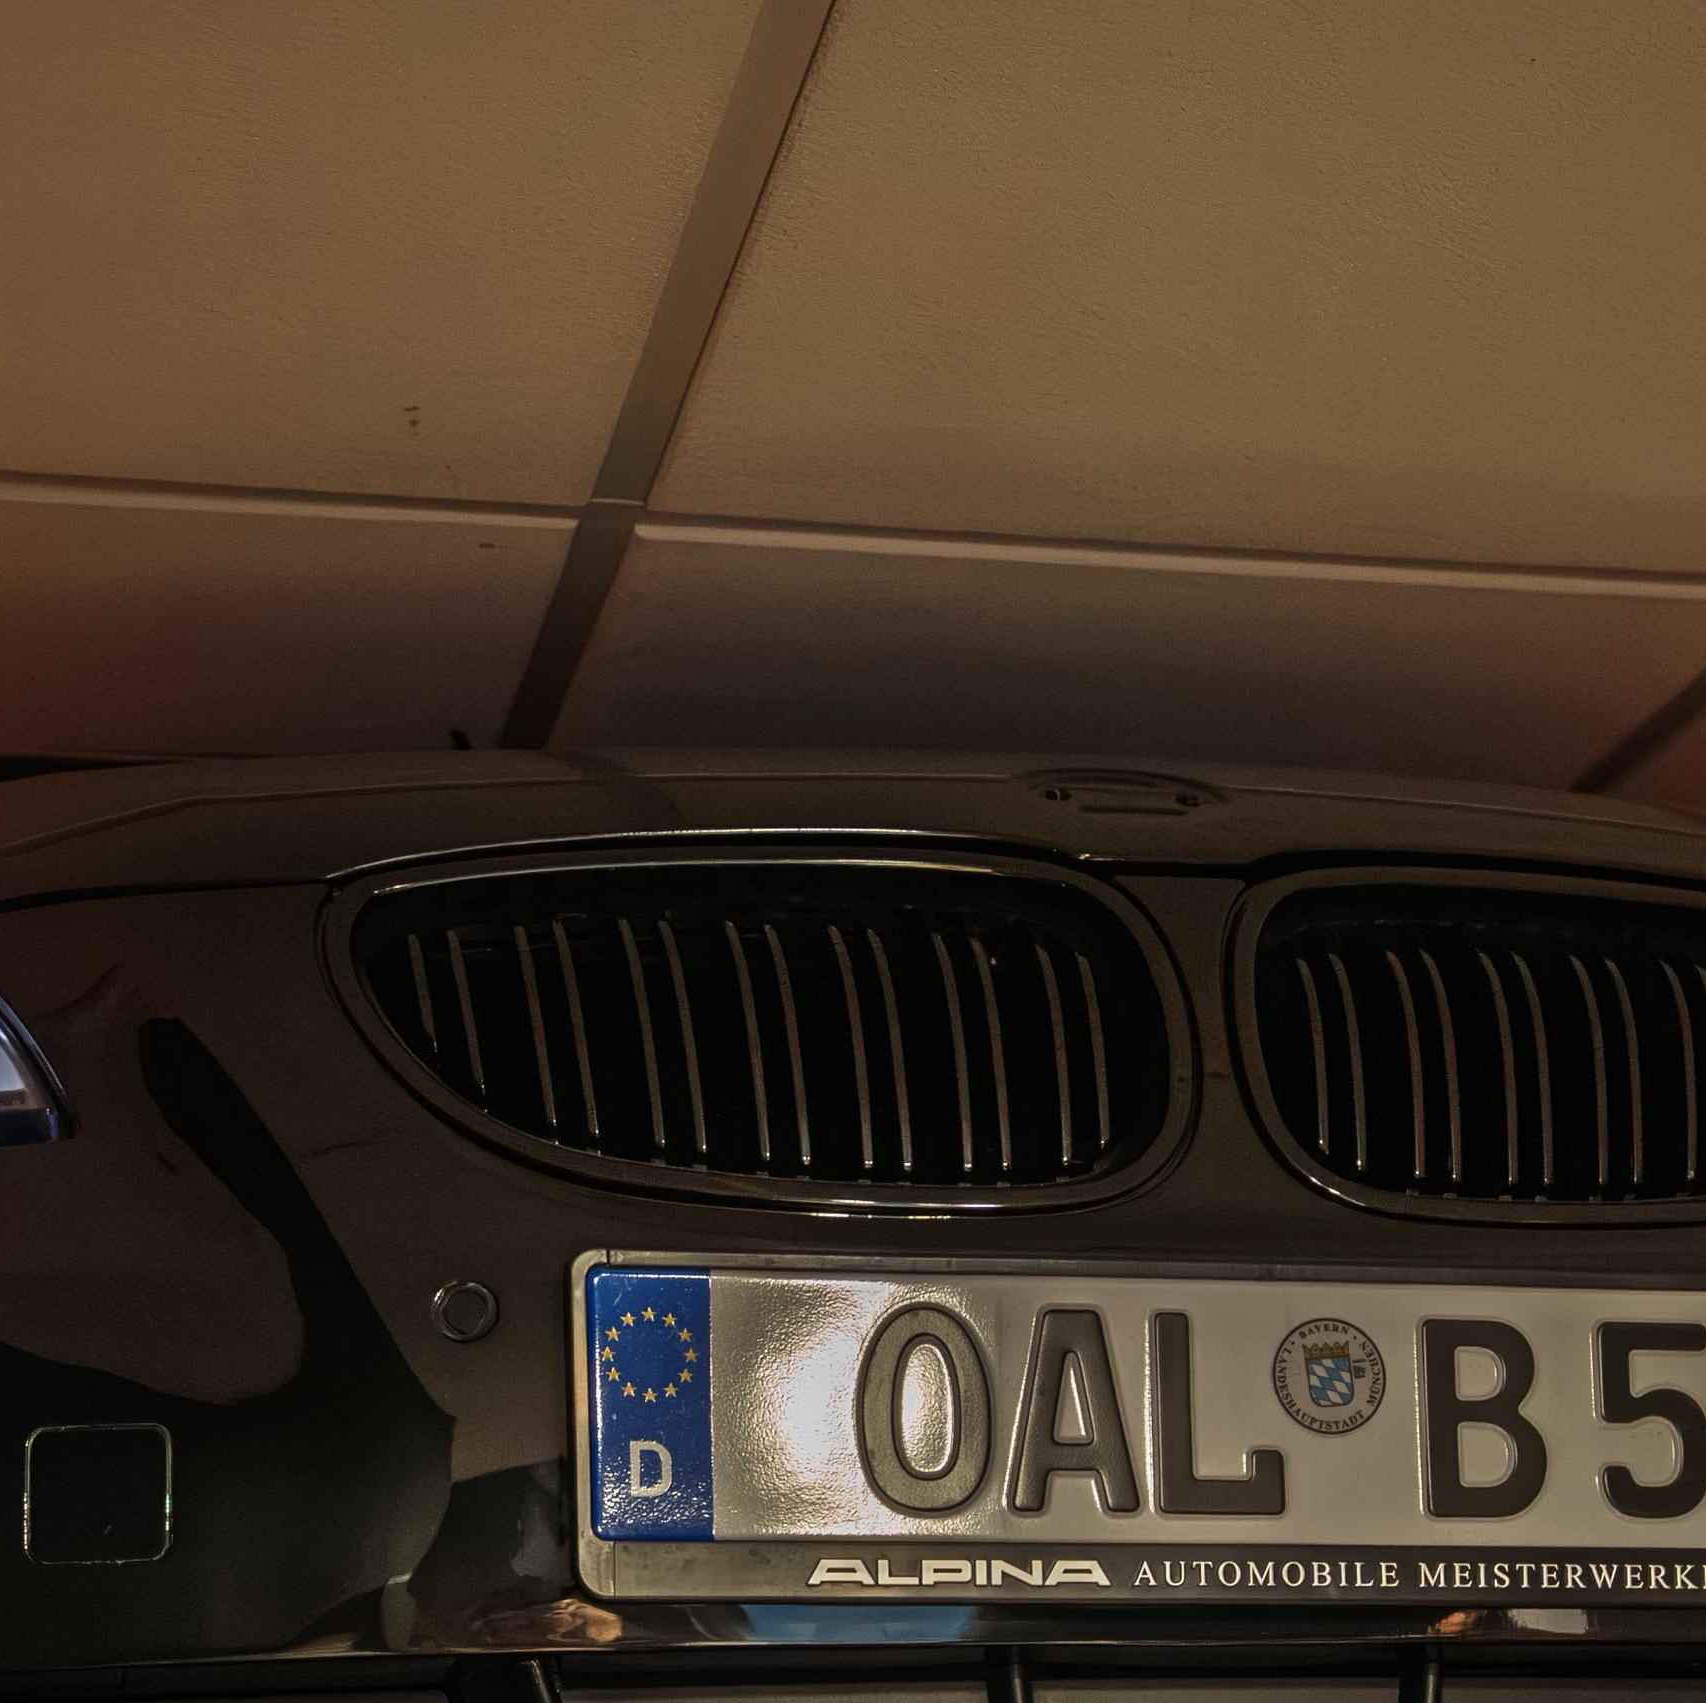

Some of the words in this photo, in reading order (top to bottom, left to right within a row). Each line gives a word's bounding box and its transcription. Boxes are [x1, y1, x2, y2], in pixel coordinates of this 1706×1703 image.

[1298, 1323, 1350, 1340] BAYERN
[856, 1301, 1287, 1517] OAL
[1420, 1316, 1549, 1519] B
[1276, 1341, 1365, 1431] LANDESHAUPTSTADT
[629, 1439, 673, 1498] D
[807, 1558, 1112, 1587] ALPINA
[1133, 1560, 1401, 1588] AUTOMOBILE
